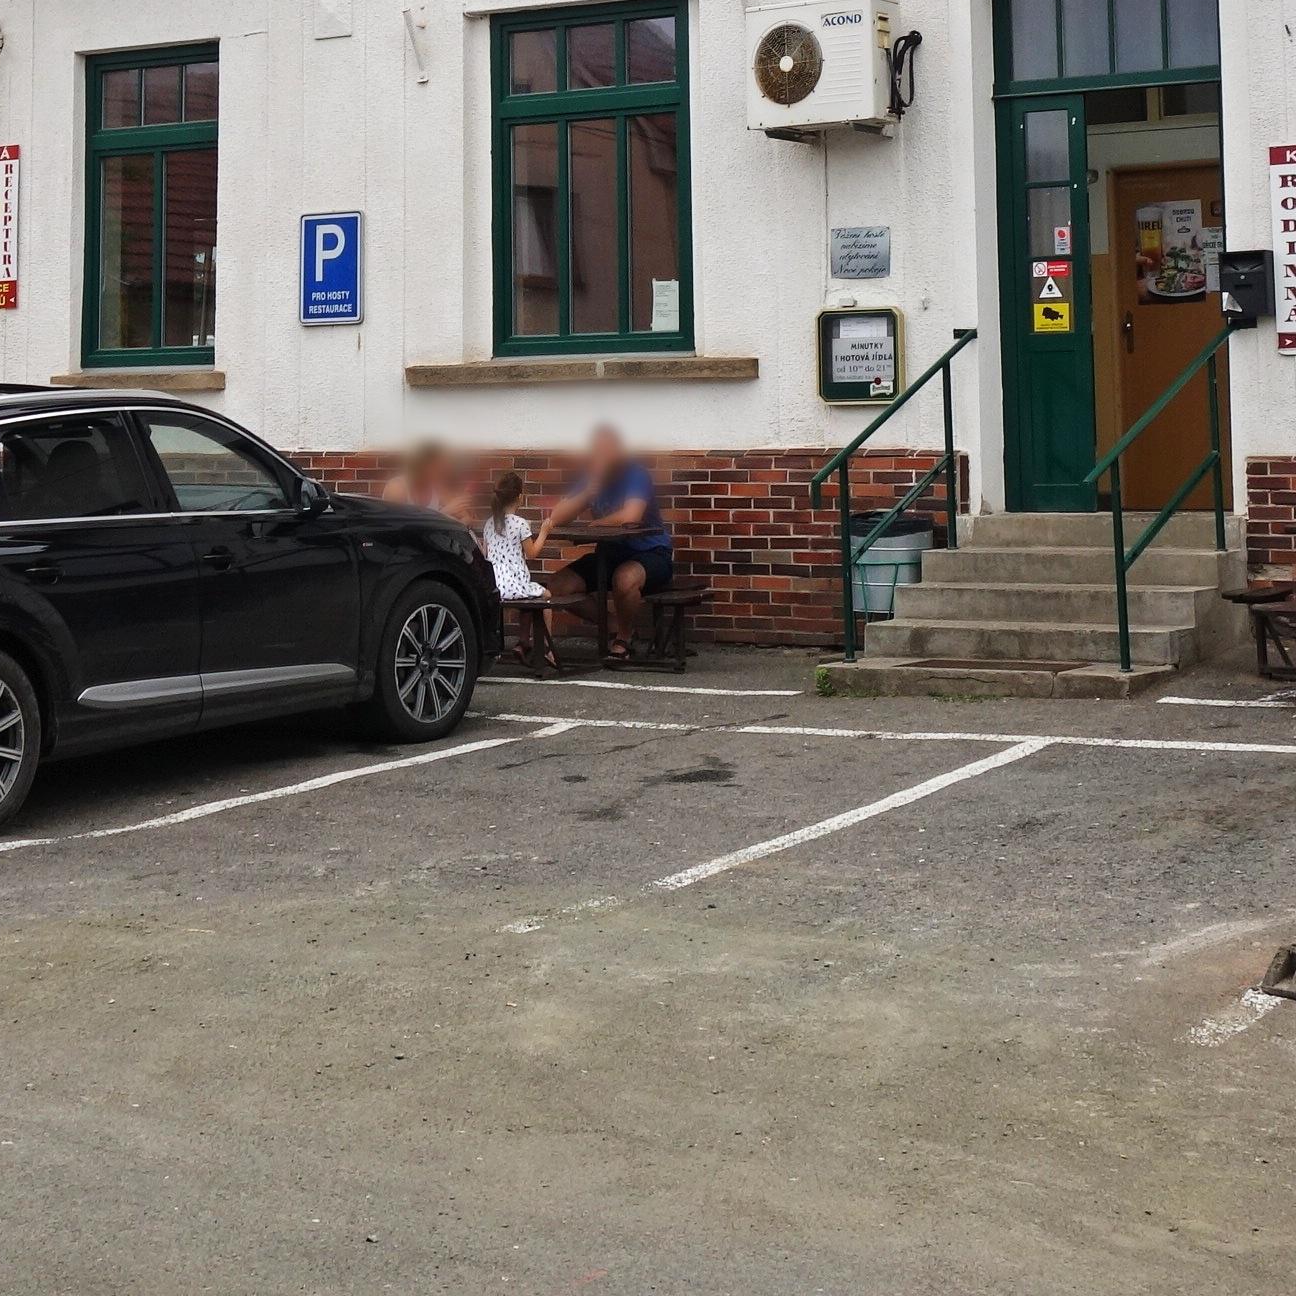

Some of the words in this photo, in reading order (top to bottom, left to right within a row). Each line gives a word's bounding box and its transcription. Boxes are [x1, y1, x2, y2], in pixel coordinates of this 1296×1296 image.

[823, 14, 862, 27] ACOND
[2, 163, 13, 279] RECEPTURA
[315, 224, 346, 282] P
[312, 292, 326, 301] PRO
[327, 291, 350, 300] HOSTY
[309, 304, 352, 314] RESTAURACE
[840, 352, 870, 362] HOTOVÁ
[872, 351, 893, 361] JÍDLA
